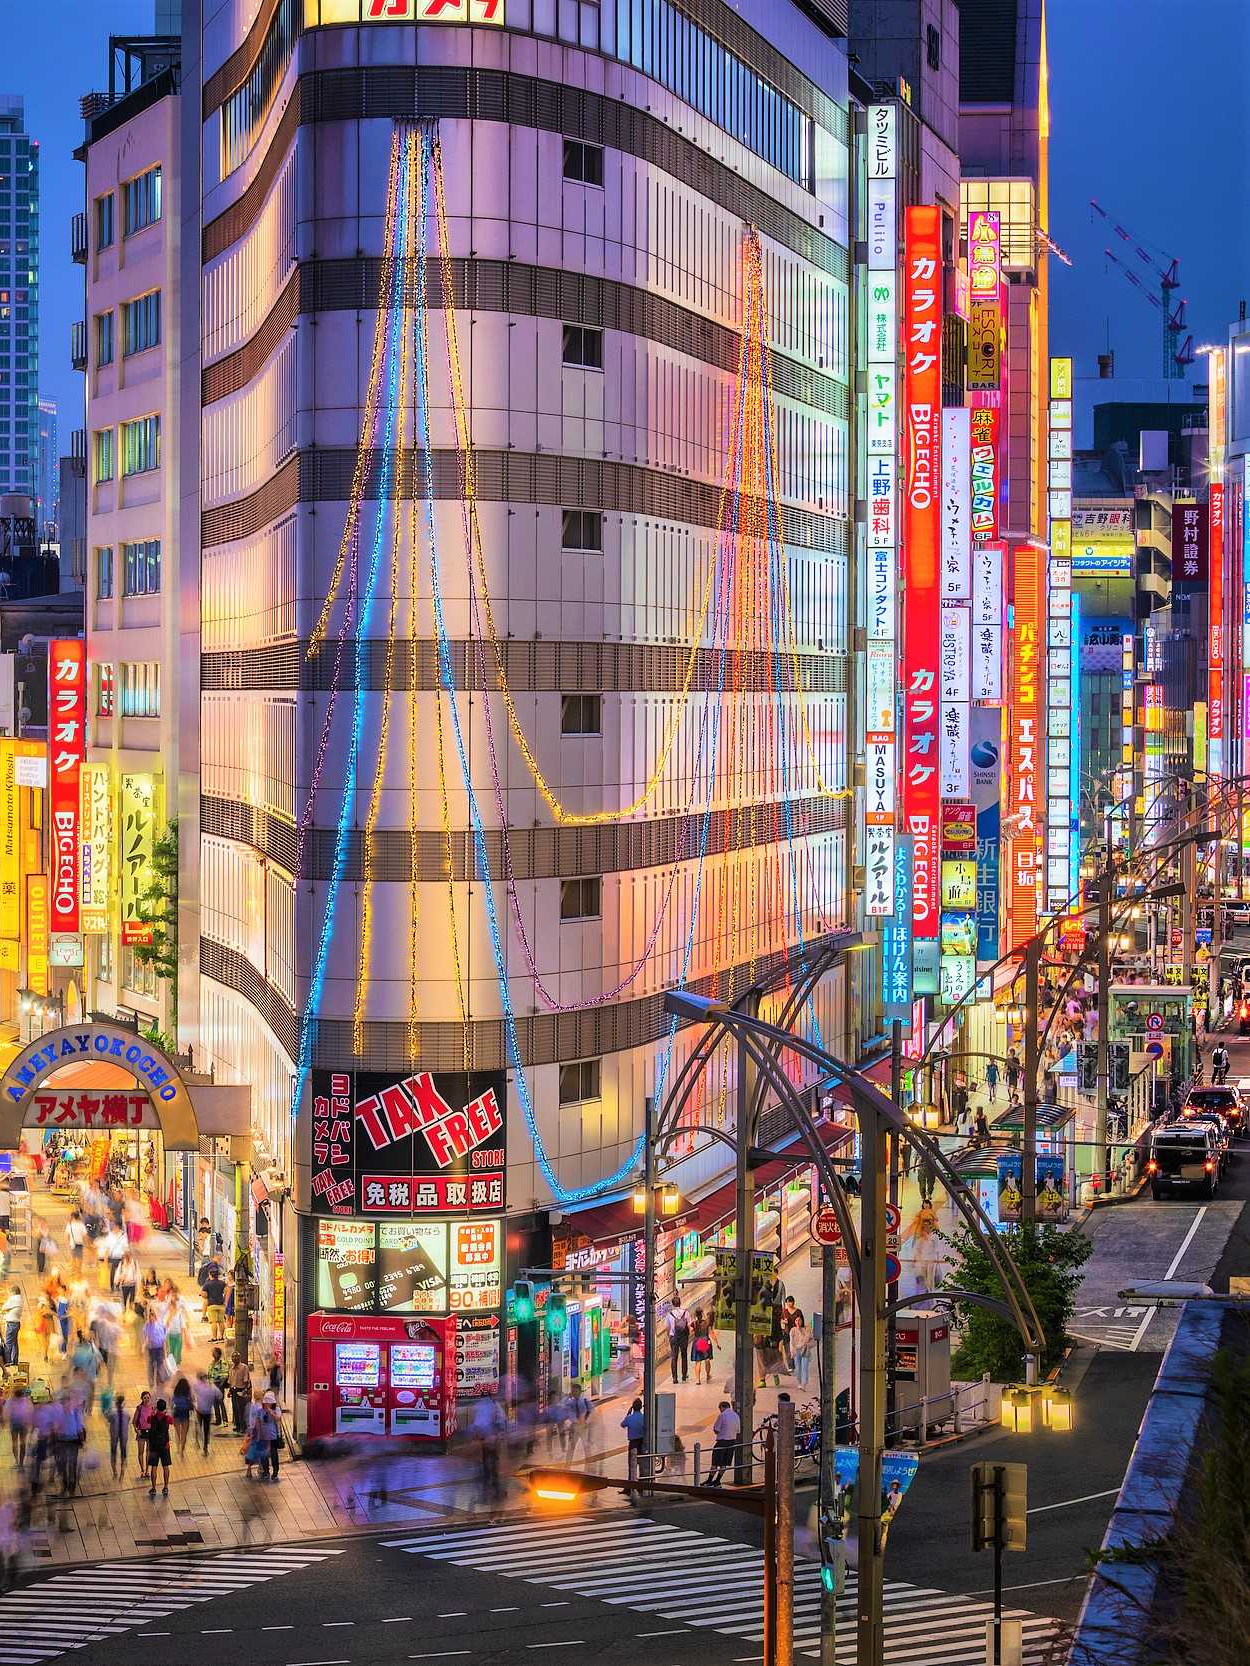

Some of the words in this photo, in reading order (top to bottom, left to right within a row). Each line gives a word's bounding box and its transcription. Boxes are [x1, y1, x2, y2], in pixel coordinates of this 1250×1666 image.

[876, 108, 891, 175] タツミビル
[876, 314, 887, 352] 株式会社
[910, 257, 937, 375] カラオケ
[972, 315, 981, 377] エスコート
[872, 374, 892, 428] ヤマト
[972, 410, 994, 443] 麻雀
[872, 459, 890, 535] 上野歯科
[1212, 493, 1222, 527] カラオケ
[1183, 510, 1199, 576] 野村證券
[875, 551, 887, 627] 富士コンタクト
[948, 583, 961, 592] 5F
[1019, 622, 1038, 703] パチンコ
[54, 659, 80, 773] カラオケ
[945, 688, 959, 697] 4F
[981, 688, 992, 696] 3F
[1211, 700, 1221, 735] カラオケ
[909, 668, 935, 786] カラオケ
[875, 744, 887, 811] MASUYA
[946, 784, 960, 793] 3F
[1018, 719, 1035, 831] エスパス
[870, 840, 890, 905] ルノアール
[976, 836, 997, 943] 新生銀行
[871, 906, 888, 914] B1F
[892, 927, 908, 1003] ほけん案内
[34, 1095, 150, 1125] アメヤ横丁
[314, 1096, 330, 1165] カメラ
[330, 1073, 350, 1167] ヨドバシ
[355, 1071, 453, 1151] TAX
[421, 1086, 504, 1169] FREE
[311, 1168, 337, 1197] TAX
[471, 1148, 505, 1169] STORE
[325, 1178, 355, 1207] FREE
[366, 1180, 502, 1207] 免税品取扱店
[319, 1222, 375, 1234] ヨドバシカメラ
[416, 1275, 443, 1290] VISA
[321, 1321, 353, 1334] Coca-Cola
